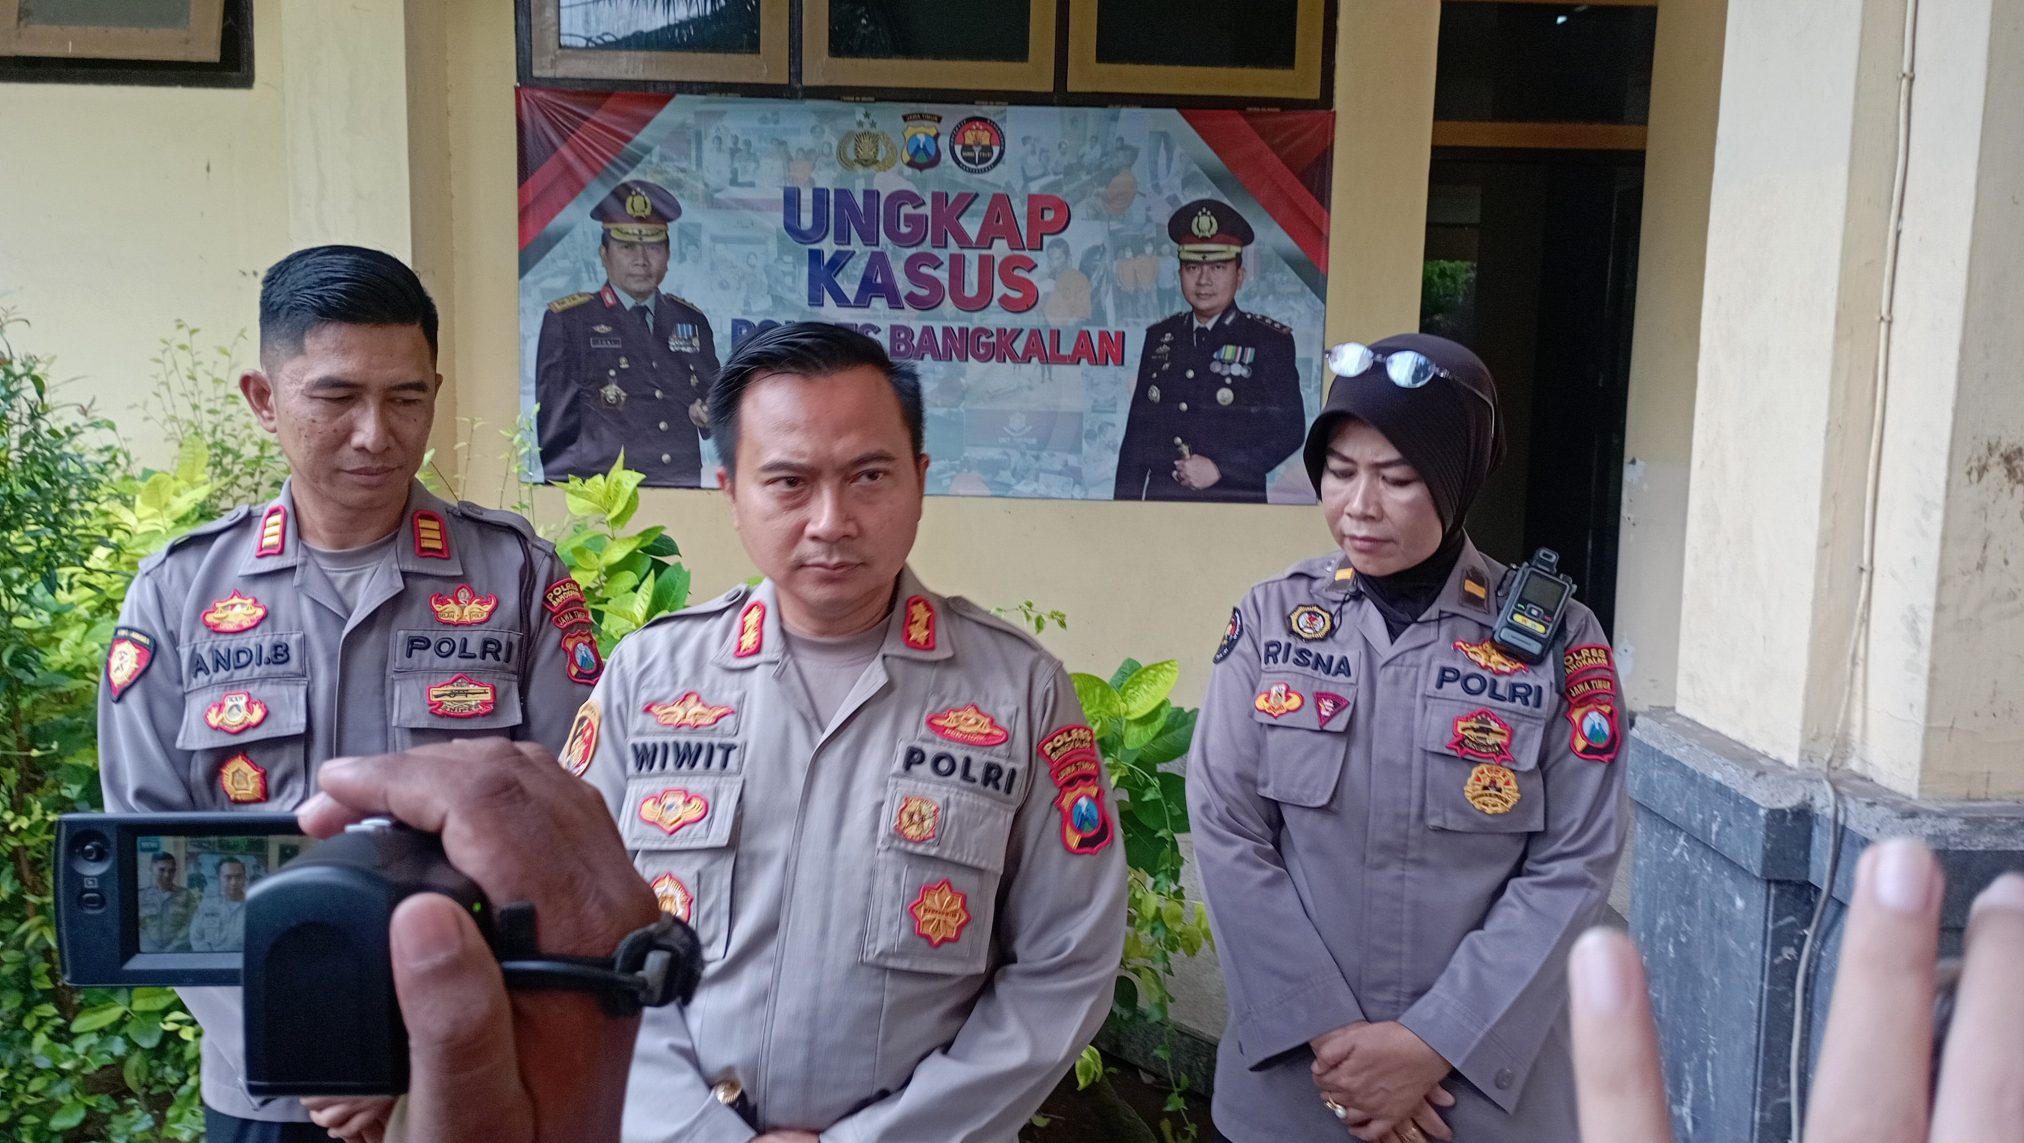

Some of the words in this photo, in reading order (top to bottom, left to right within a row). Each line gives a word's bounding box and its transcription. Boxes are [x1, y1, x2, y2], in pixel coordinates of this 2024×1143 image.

[783, 186, 1071, 251] UNGKAP
[807, 248, 1039, 313] KASUS
[889, 323, 1125, 366] BANGKALAN
[192, 643, 291, 679] ANDI.B
[405, 635, 514, 664] POLRI
[1263, 640, 1352, 678] RISNA
[1564, 648, 1607, 666] OLRES
[1435, 665, 1542, 709] POLRI
[1569, 681, 1591, 697] JAWA
[631, 742, 737, 772] WIWIT
[903, 746, 1017, 795] POLRI
